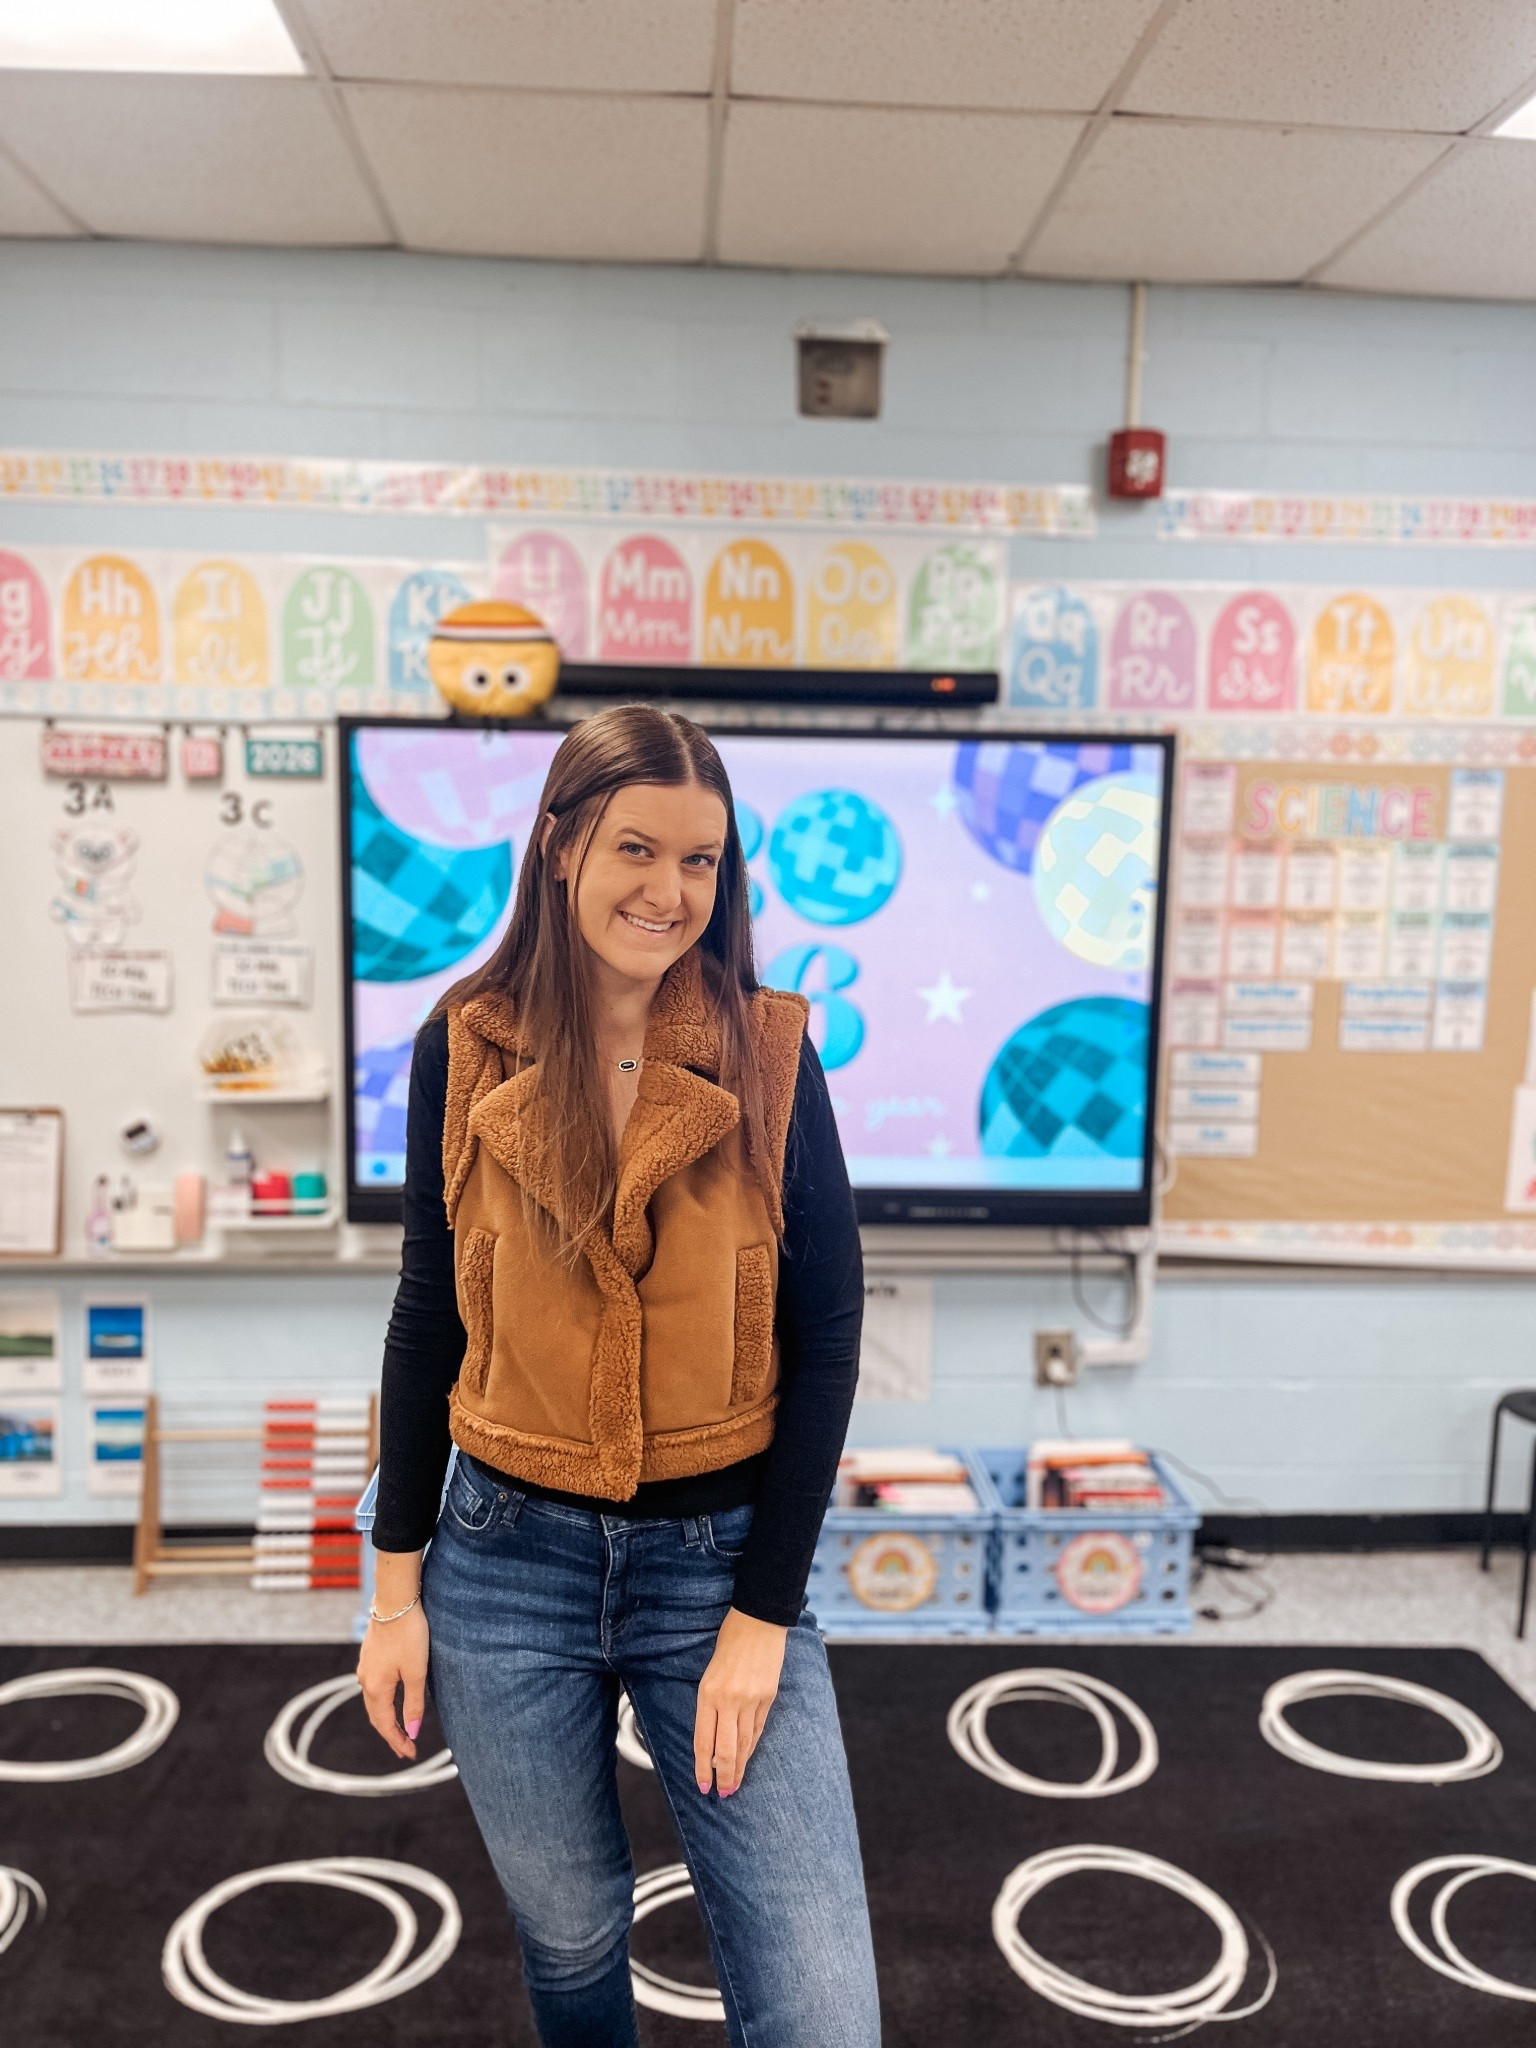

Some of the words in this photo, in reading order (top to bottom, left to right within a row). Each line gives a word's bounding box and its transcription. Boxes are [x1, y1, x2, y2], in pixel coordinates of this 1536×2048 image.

[80, 566, 142, 618] Hh
[610, 549, 688, 603] Mm
[719, 550, 781, 603] Nn
[815, 554, 890, 607] Oo
[301, 570, 354, 637] Jj
[1130, 601, 1182, 650] Rr
[1328, 604, 1377, 654] Tt
[1233, 605, 1282, 655] Ss
[1017, 648, 1084, 713] Qq
[1119, 654, 1193, 704] Rr
[250, 745, 319, 773] 2026
[1248, 783, 1436, 839] SCIENCE
